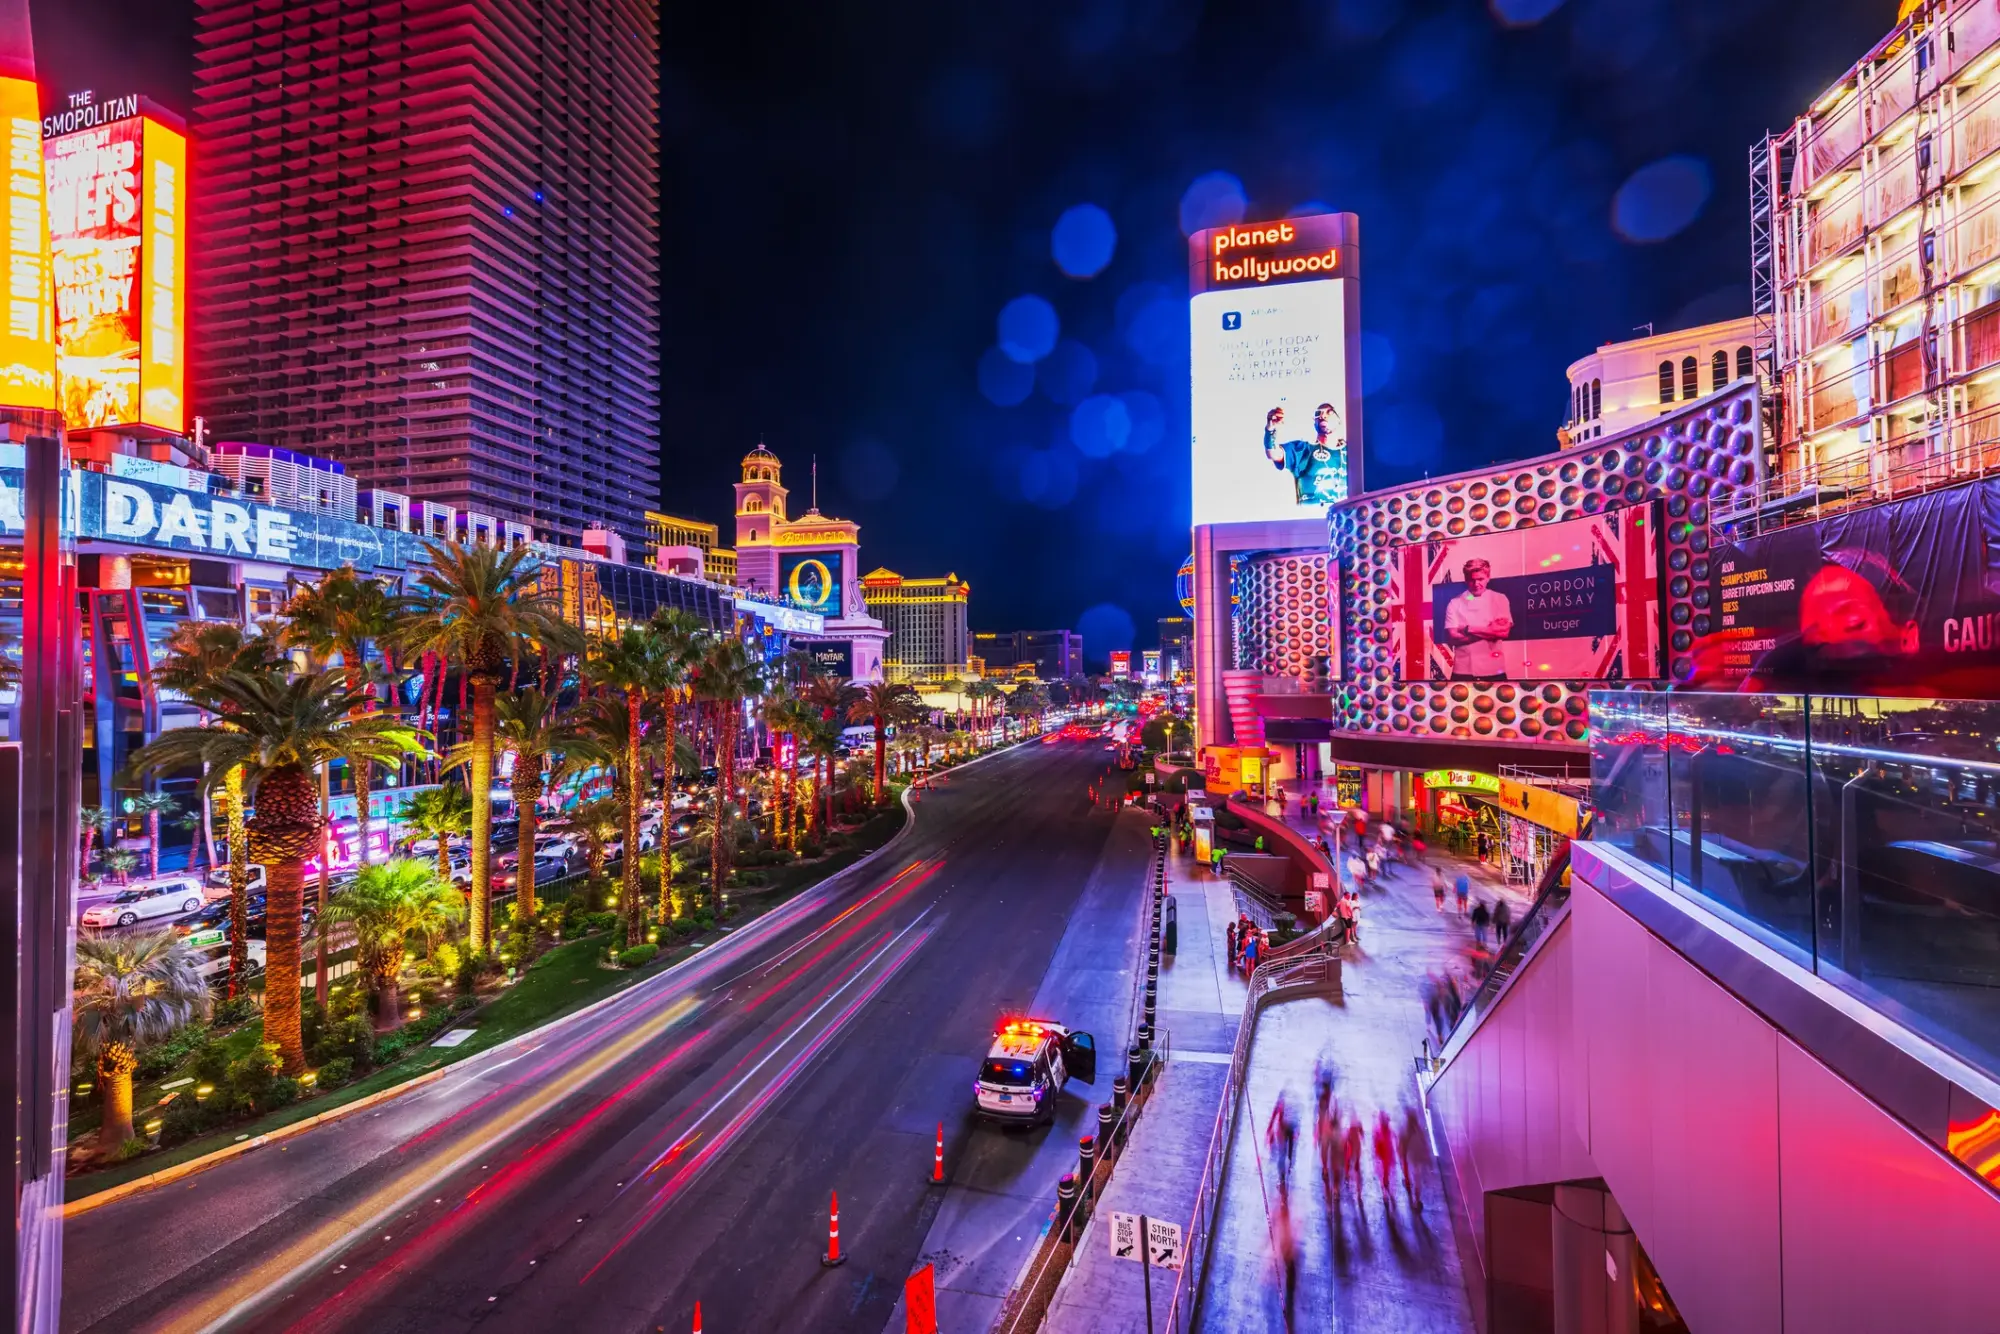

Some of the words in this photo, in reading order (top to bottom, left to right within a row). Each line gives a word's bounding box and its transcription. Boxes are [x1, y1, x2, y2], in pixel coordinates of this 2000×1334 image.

[69, 90, 92, 108] THE
[1215, 223, 1294, 255] planet
[1215, 249, 1337, 282] hollywood
[1280, 334, 1320, 345] TODAY
[1261, 345, 1309, 357] OFFERS
[1232, 359, 1285, 371] WORTHY
[1292, 356, 1307, 366] OF
[1228, 373, 1245, 381] AN
[1252, 367, 1311, 380] EMPEROR
[106, 479, 292, 560] DARE
[782, 530, 846, 543] BELLAGIO
[1722, 561, 1735, 573] ALDO
[789, 559, 832, 606] O
[1721, 572, 1744, 586] CHAMPS
[1744, 568, 1768, 582] SPORTS
[1527, 576, 1595, 595] GORDON
[1722, 586, 1745, 599] GARRETT
[1746, 582, 1773, 596] POPCORN
[1774, 578, 1795, 592] SHOPS
[1527, 591, 1595, 610] RAMSAY
[1722, 601, 1739, 613] GUESS
[1543, 619, 1580, 631] burger
[1742, 638, 1776, 651] COSMETICS
[815, 652, 845, 662] MAYFAIR
[1447, 770, 1477, 785] Pin-up
[1118, 1221, 1131, 1230] BUS
[1152, 1223, 1176, 1237] STRIP
[1117, 1229, 1133, 1237] STOP
[1117, 1236, 1133, 1244] ONLY
[1150, 1233, 1178, 1248] NORTH
